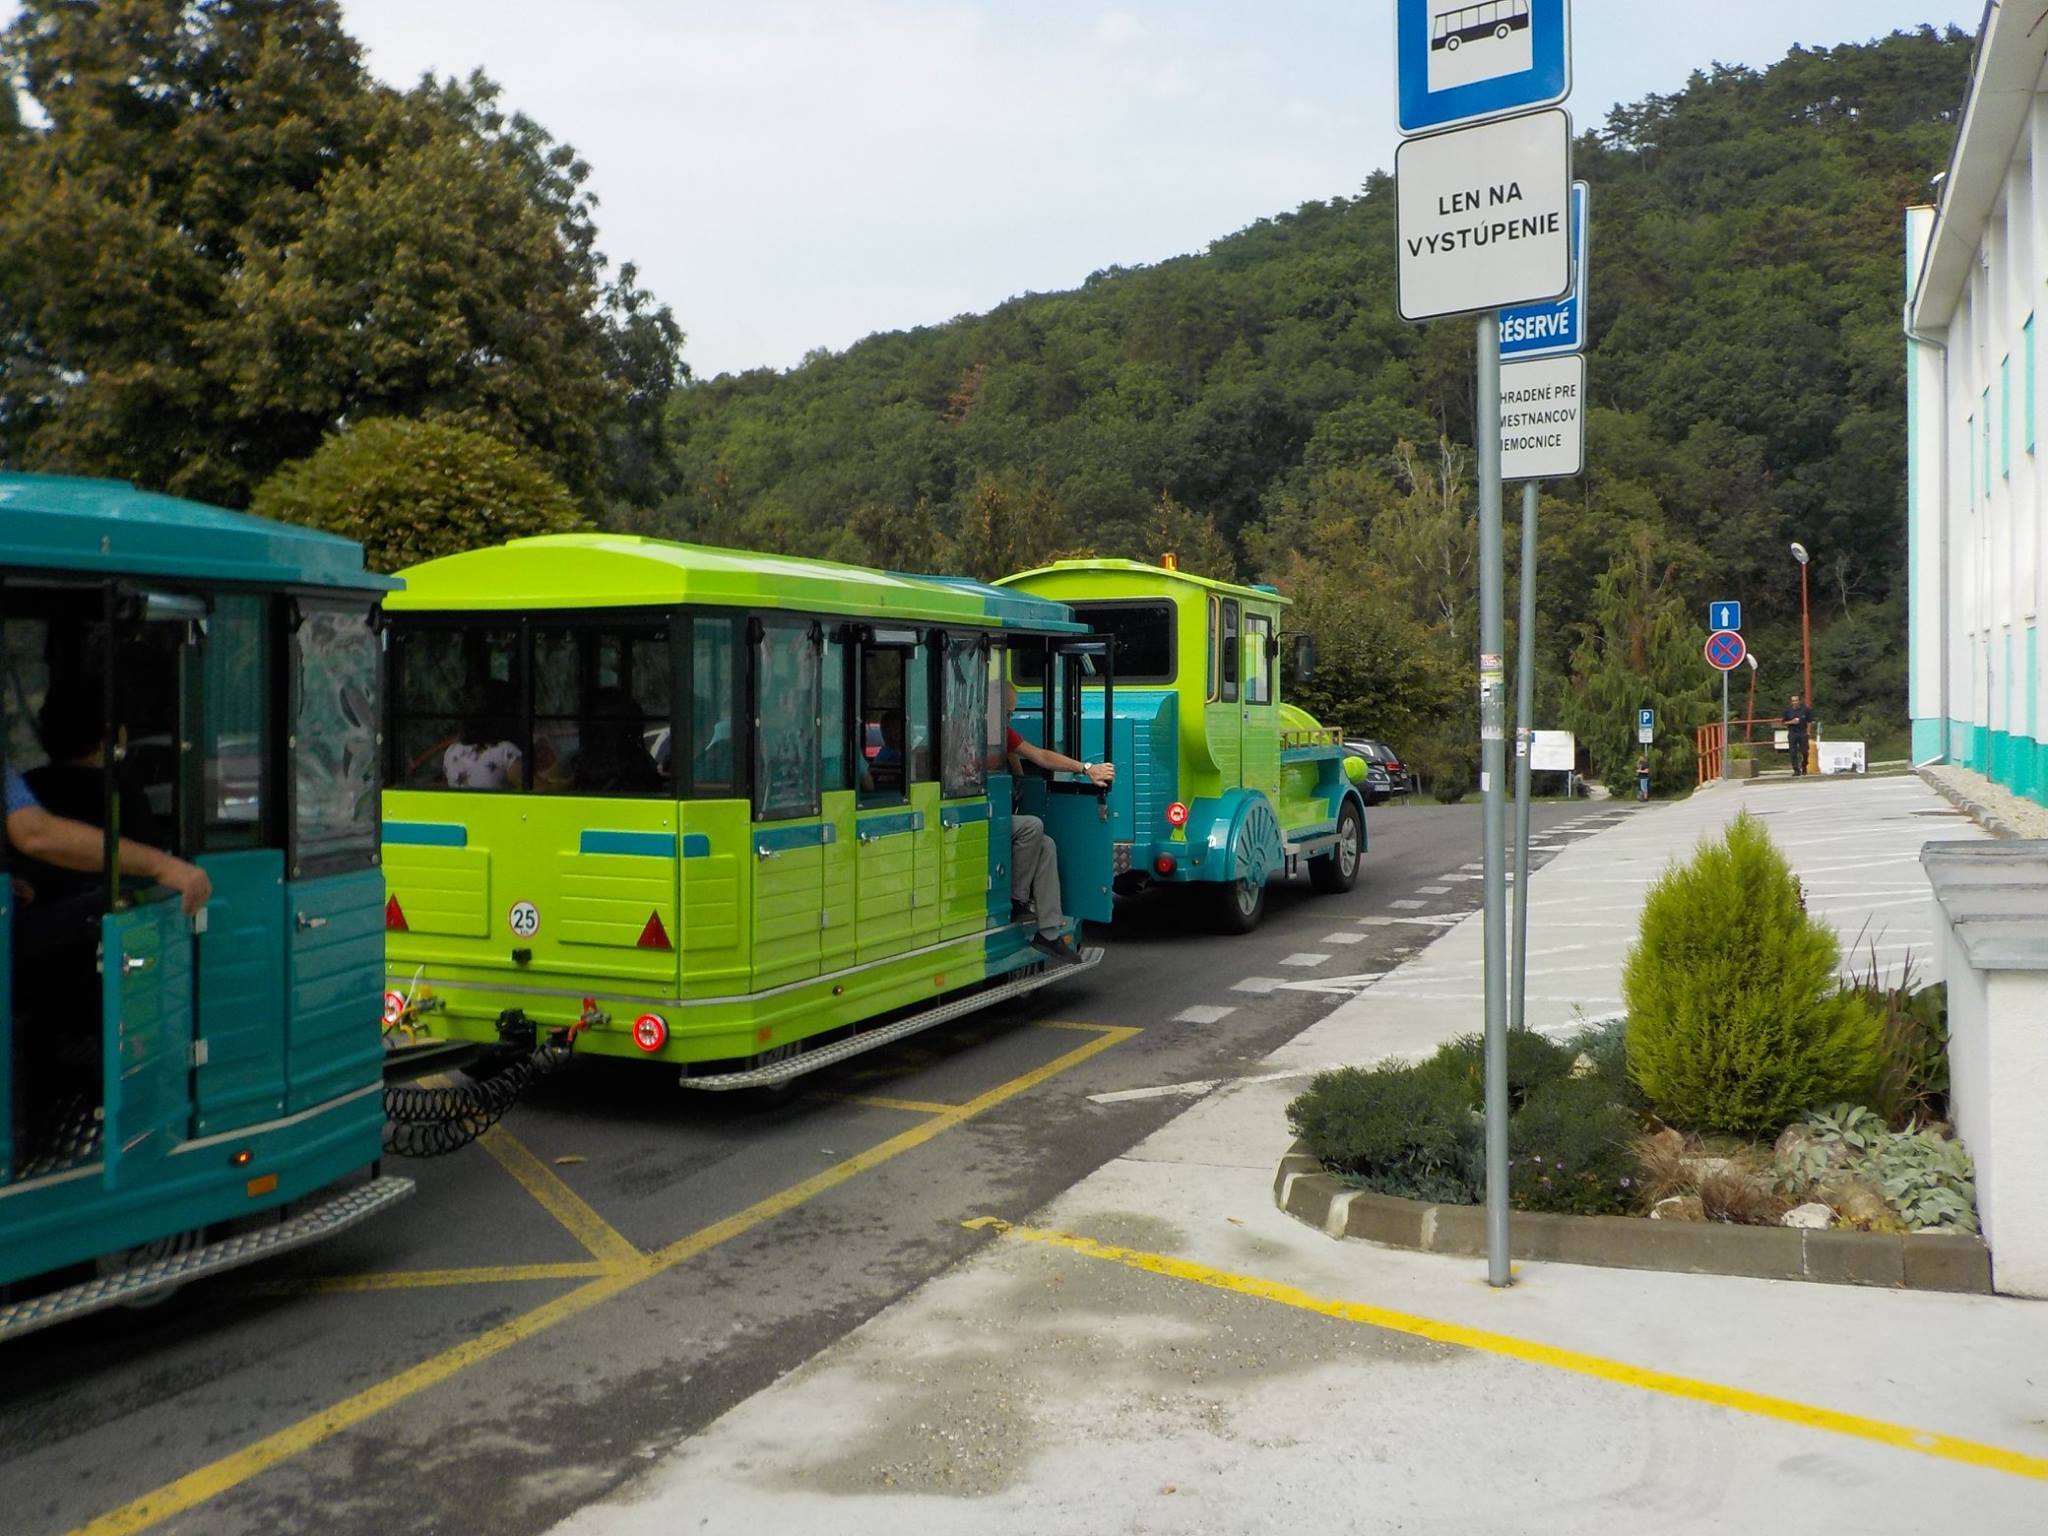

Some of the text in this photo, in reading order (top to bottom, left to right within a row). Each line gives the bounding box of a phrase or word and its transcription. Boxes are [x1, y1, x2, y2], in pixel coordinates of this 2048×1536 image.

[1438, 181, 1523, 216] LEN NA
[1407, 211, 1560, 257] VYSTÚPENIE
[1554, 384, 1576, 399] PRE
[1642, 711, 1650, 723] P
[513, 908, 536, 929] 25
